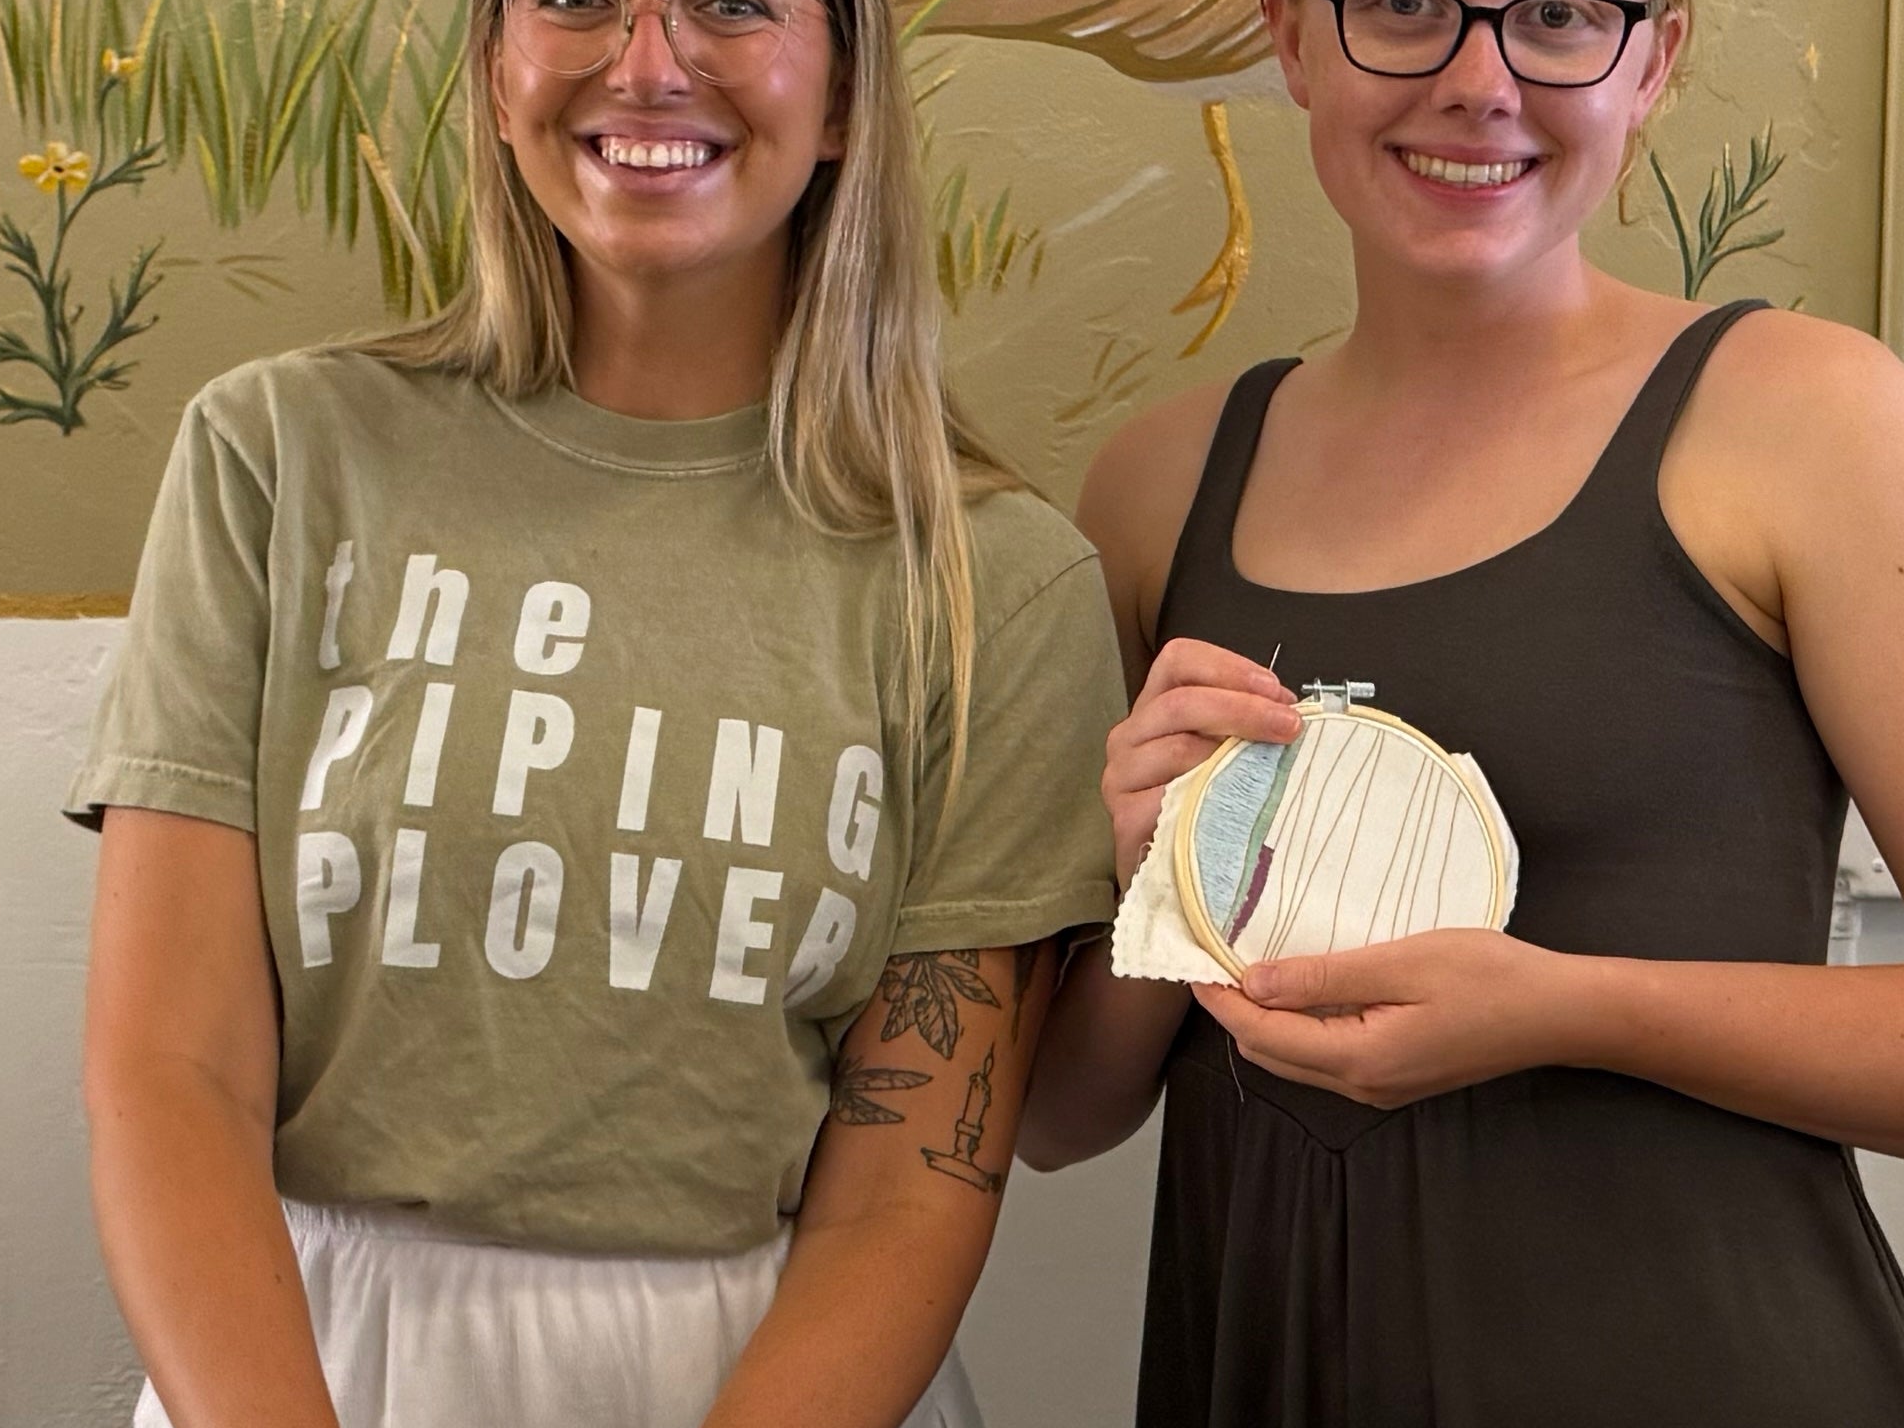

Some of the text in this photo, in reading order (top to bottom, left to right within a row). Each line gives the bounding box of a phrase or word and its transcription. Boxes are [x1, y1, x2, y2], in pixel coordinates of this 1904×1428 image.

[317, 538, 593, 676] the
[298, 682, 886, 882] PIPING
[295, 828, 861, 1009] PLOVER
